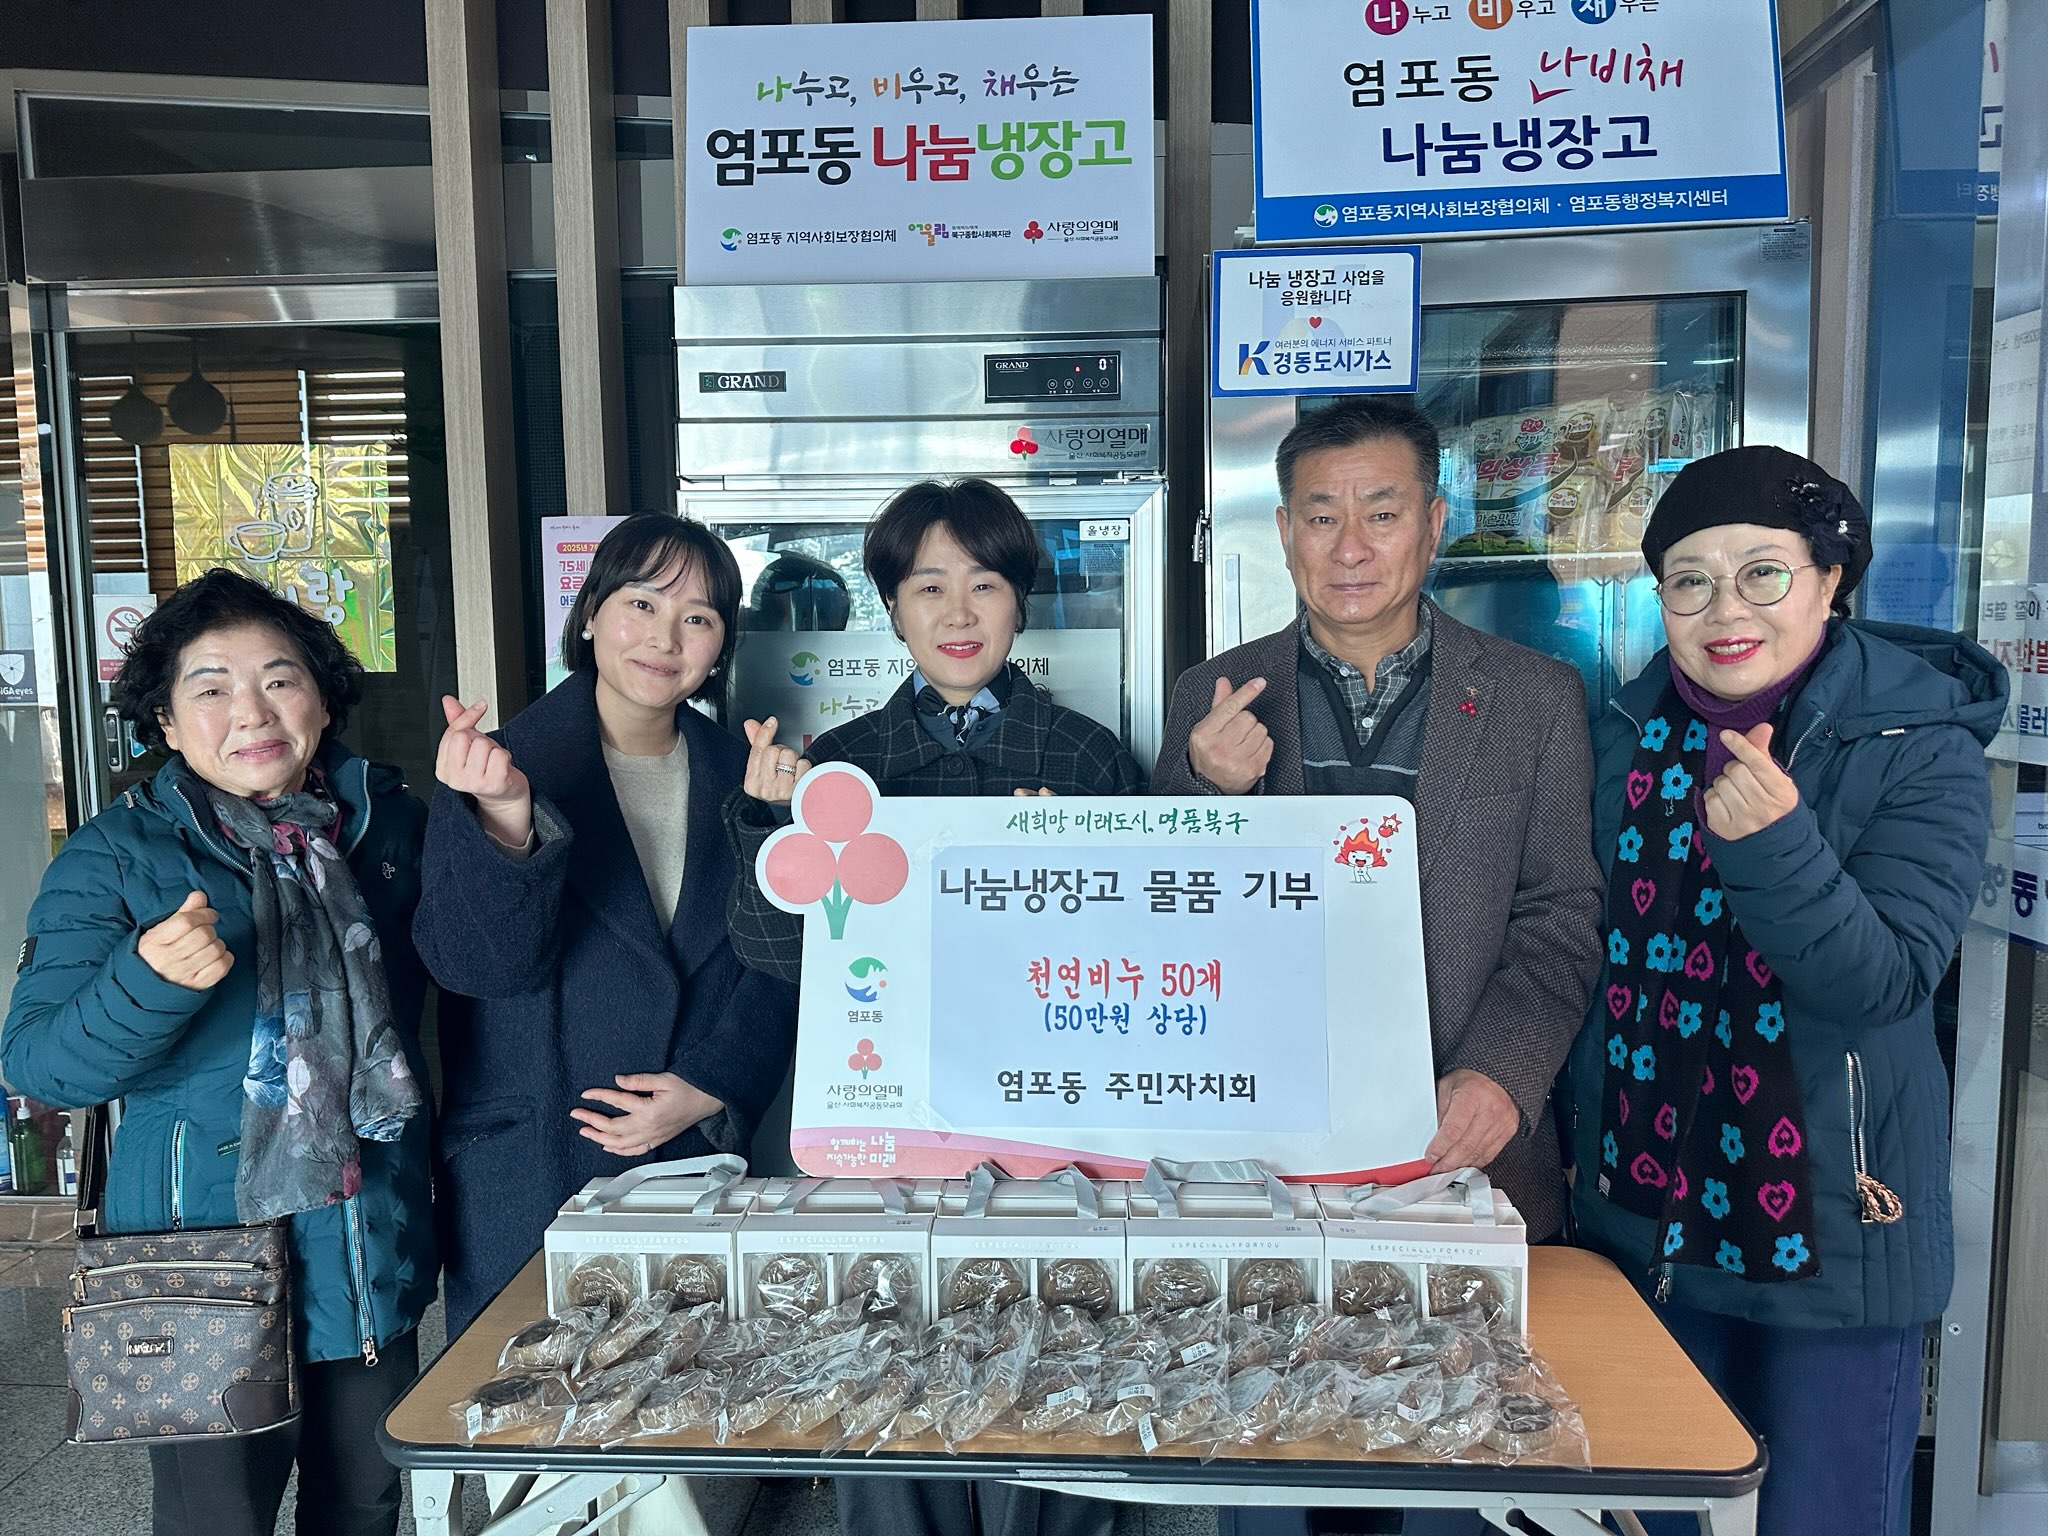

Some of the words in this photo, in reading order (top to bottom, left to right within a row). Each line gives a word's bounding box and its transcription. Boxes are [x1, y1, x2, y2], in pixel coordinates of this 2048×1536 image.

[757, 71, 858, 107] 나누고,
[874, 66, 966, 104] 비우고,
[983, 63, 1079, 98] 채우는
[1343, 55, 1500, 108] 염포동
[1540, 43, 1684, 93] 나비채
[706, 126, 861, 187] 염포동
[873, 120, 1133, 181] 나눔냉장고
[1382, 115, 1658, 177] 나눔냉장고
[1341, 197, 1550, 223] 염포동지역사회보장협의체
[1570, 189, 1729, 213] 염포동행정복지센터
[746, 230, 782, 245] 염포동
[786, 228, 897, 244] 지역사회보장협의체
[1047, 220, 1119, 236] 사랑의열매
[1249, 271, 1281, 288] 나눔
[1288, 269, 1337, 288] 냉장고
[1342, 269, 1385, 286] 사업을
[1280, 290, 1352, 307] 응원합니다
[1274, 339, 1309, 349] 여러분의
[1311, 338, 1336, 348] 에너지
[1338, 337, 1364, 347] 서비스
[1366, 337, 1392, 346] 파트너
[995, 361, 1030, 370] GRAND
[1273, 349, 1392, 375] 경동도시가스
[717, 375, 780, 389] GRAND
[1044, 428, 1148, 450] 사랑의열매
[1068, 452, 1083, 460] 울산
[1087, 525, 1122, 536] 올냉장
[827, 658, 881, 678] 염포동
[1006, 808, 1068, 835] 새희망
[1159, 807, 1250, 836] 명품북구
[939, 866, 1125, 914] 나눔냉장고
[1143, 869, 1221, 914] 물품
[1242, 871, 1319, 911] 기부
[1026, 956, 1144, 1001] 천연비누
[1161, 959, 1222, 1002] 50개
[847, 1010, 884, 1023] 염포동
[1044, 1002, 1130, 1035] (50만원
[1146, 1003, 1207, 1036] 상당)
[826, 1084, 903, 1100] 사랑의열매
[997, 1069, 1087, 1104] 염포동
[1105, 1072, 1256, 1104] 주민자치회
[870, 1132, 895, 1152] 나눔
[869, 1153, 896, 1168] 미래
